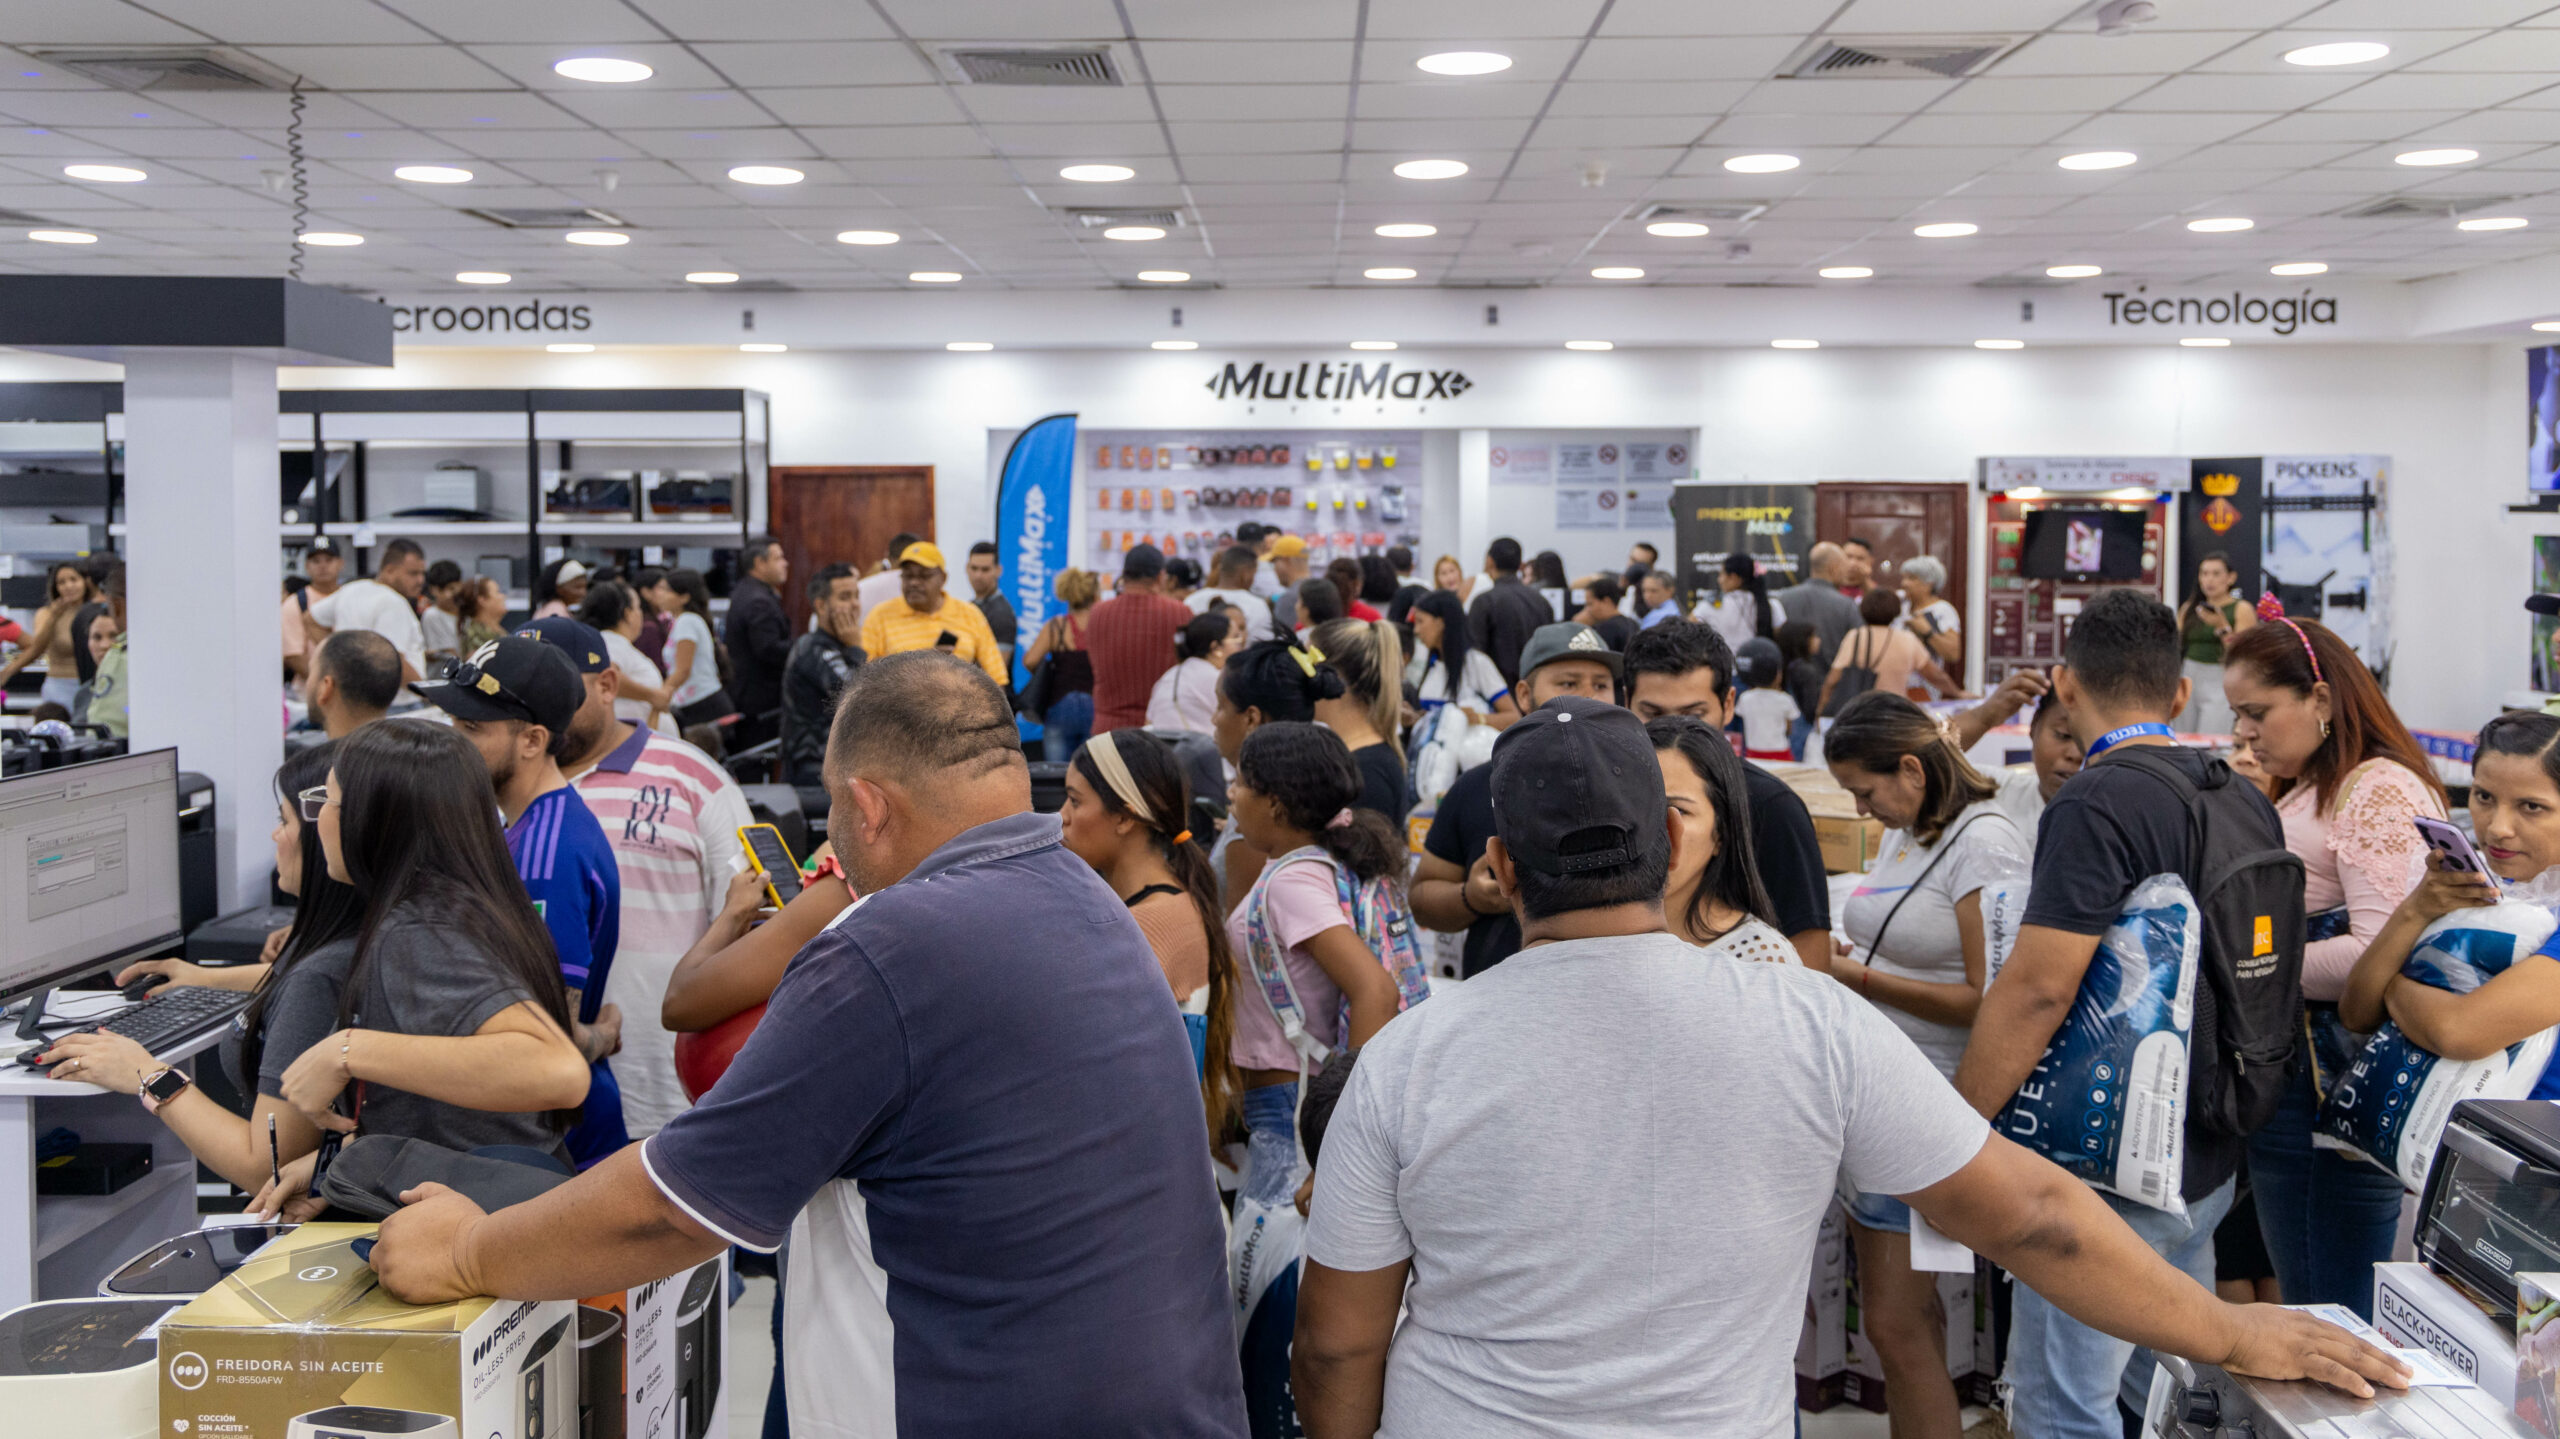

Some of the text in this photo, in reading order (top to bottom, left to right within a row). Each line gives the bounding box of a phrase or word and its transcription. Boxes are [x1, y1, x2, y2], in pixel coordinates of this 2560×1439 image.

[379, 297, 592, 332] croondas
[1217, 362, 1451, 400] MultiMax
[2275, 461, 2360, 479] PICKENS
[1696, 506, 1794, 521] PRIORITY
[1016, 503, 1047, 653] MultiMax
[2104, 724, 2147, 745] TECNO
[2474, 1068, 2493, 1093] A0106
[2132, 1091, 2147, 1150] ADVERTENCIA
[2412, 1079, 2443, 1132] ADVERTENCIA
[1238, 1223, 1264, 1307] MultiMax
[2477, 1240, 2512, 1266] BLACK+DECKER
[493, 1300, 542, 1347] PREMIE
[635, 1306, 662, 1339] OIL-LESS
[2384, 1294, 2474, 1378] BLACK+DECKER
[216, 1358, 384, 1374] FREIDORA SIN ACEITE
[473, 1352, 505, 1389] OIL-LESS
[505, 1330, 526, 1358] FRYER
[216, 1374, 284, 1386] FRD-8550AFW
[198, 1413, 236, 1423] COCCIÓN
[198, 1423, 244, 1432] SIN ACEITE
